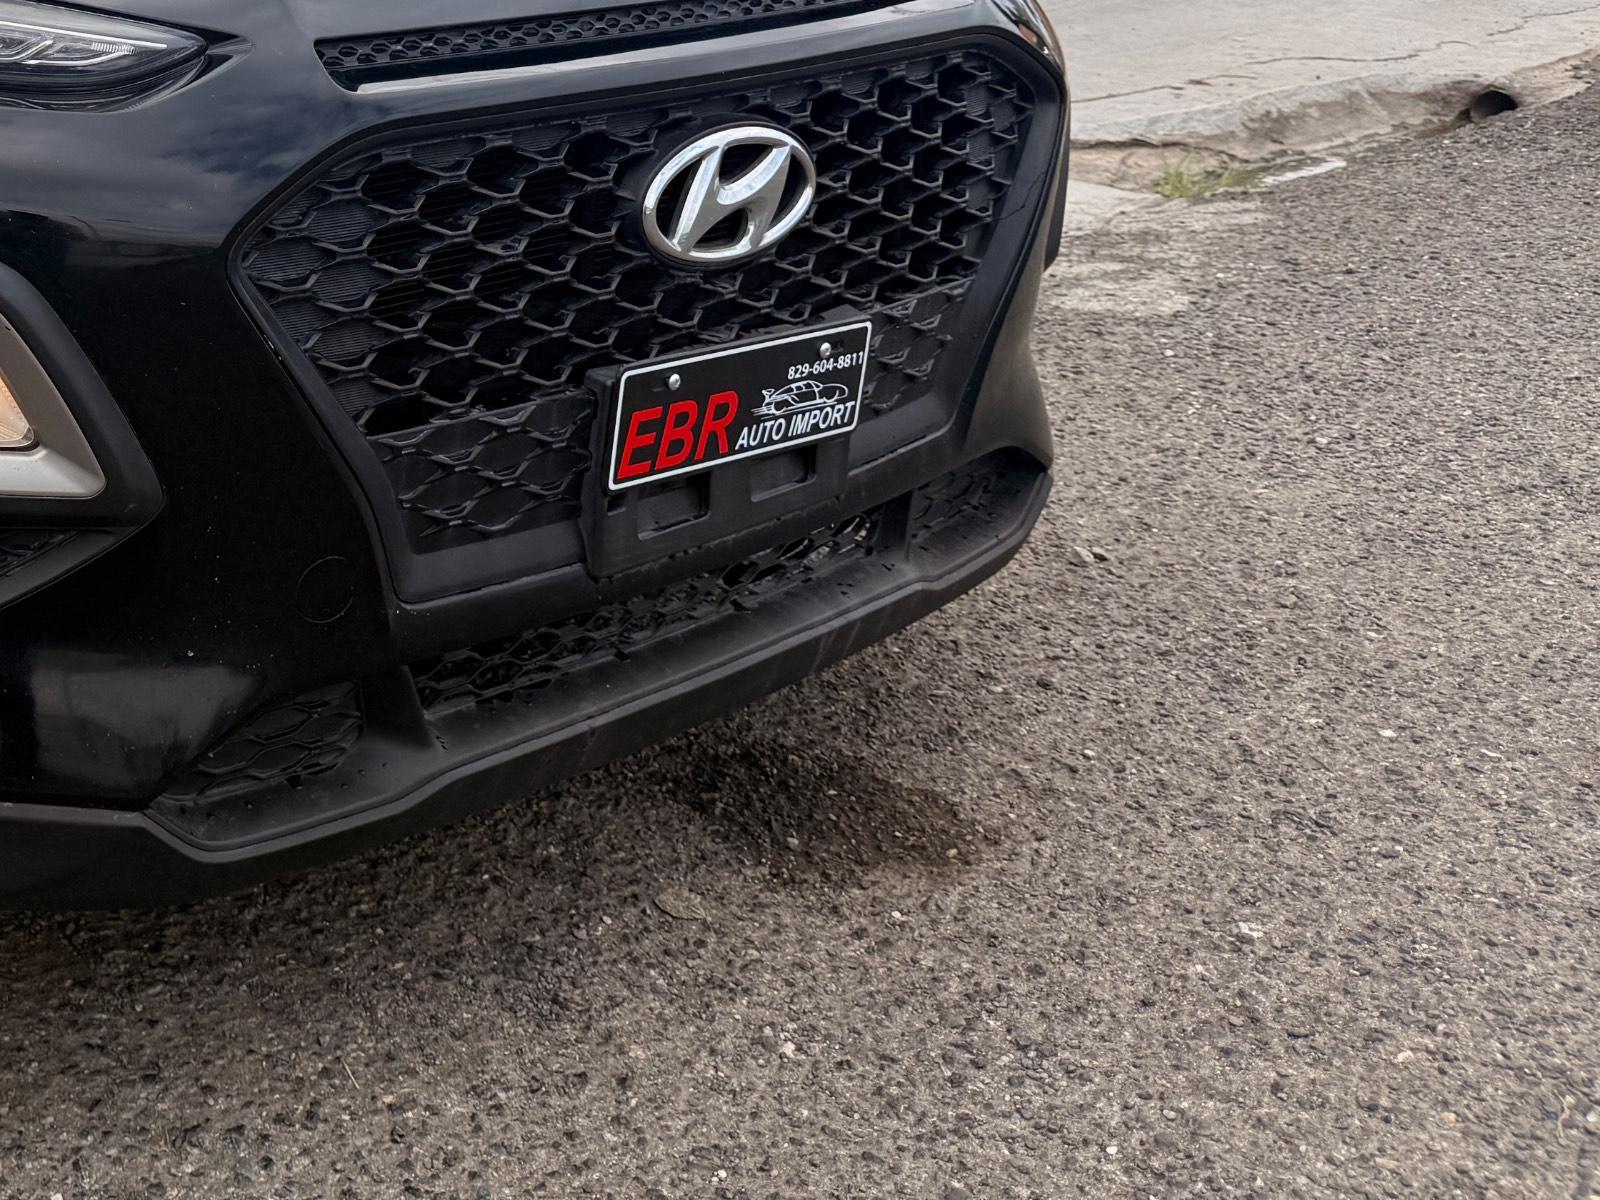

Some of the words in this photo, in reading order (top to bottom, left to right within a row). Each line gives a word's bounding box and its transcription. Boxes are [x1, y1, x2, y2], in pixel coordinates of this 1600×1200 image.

[787, 351, 865, 380] 829-604-8811
[616, 390, 740, 480] EBR
[735, 417, 787, 451] AUTO
[788, 400, 856, 438] IMPORT
